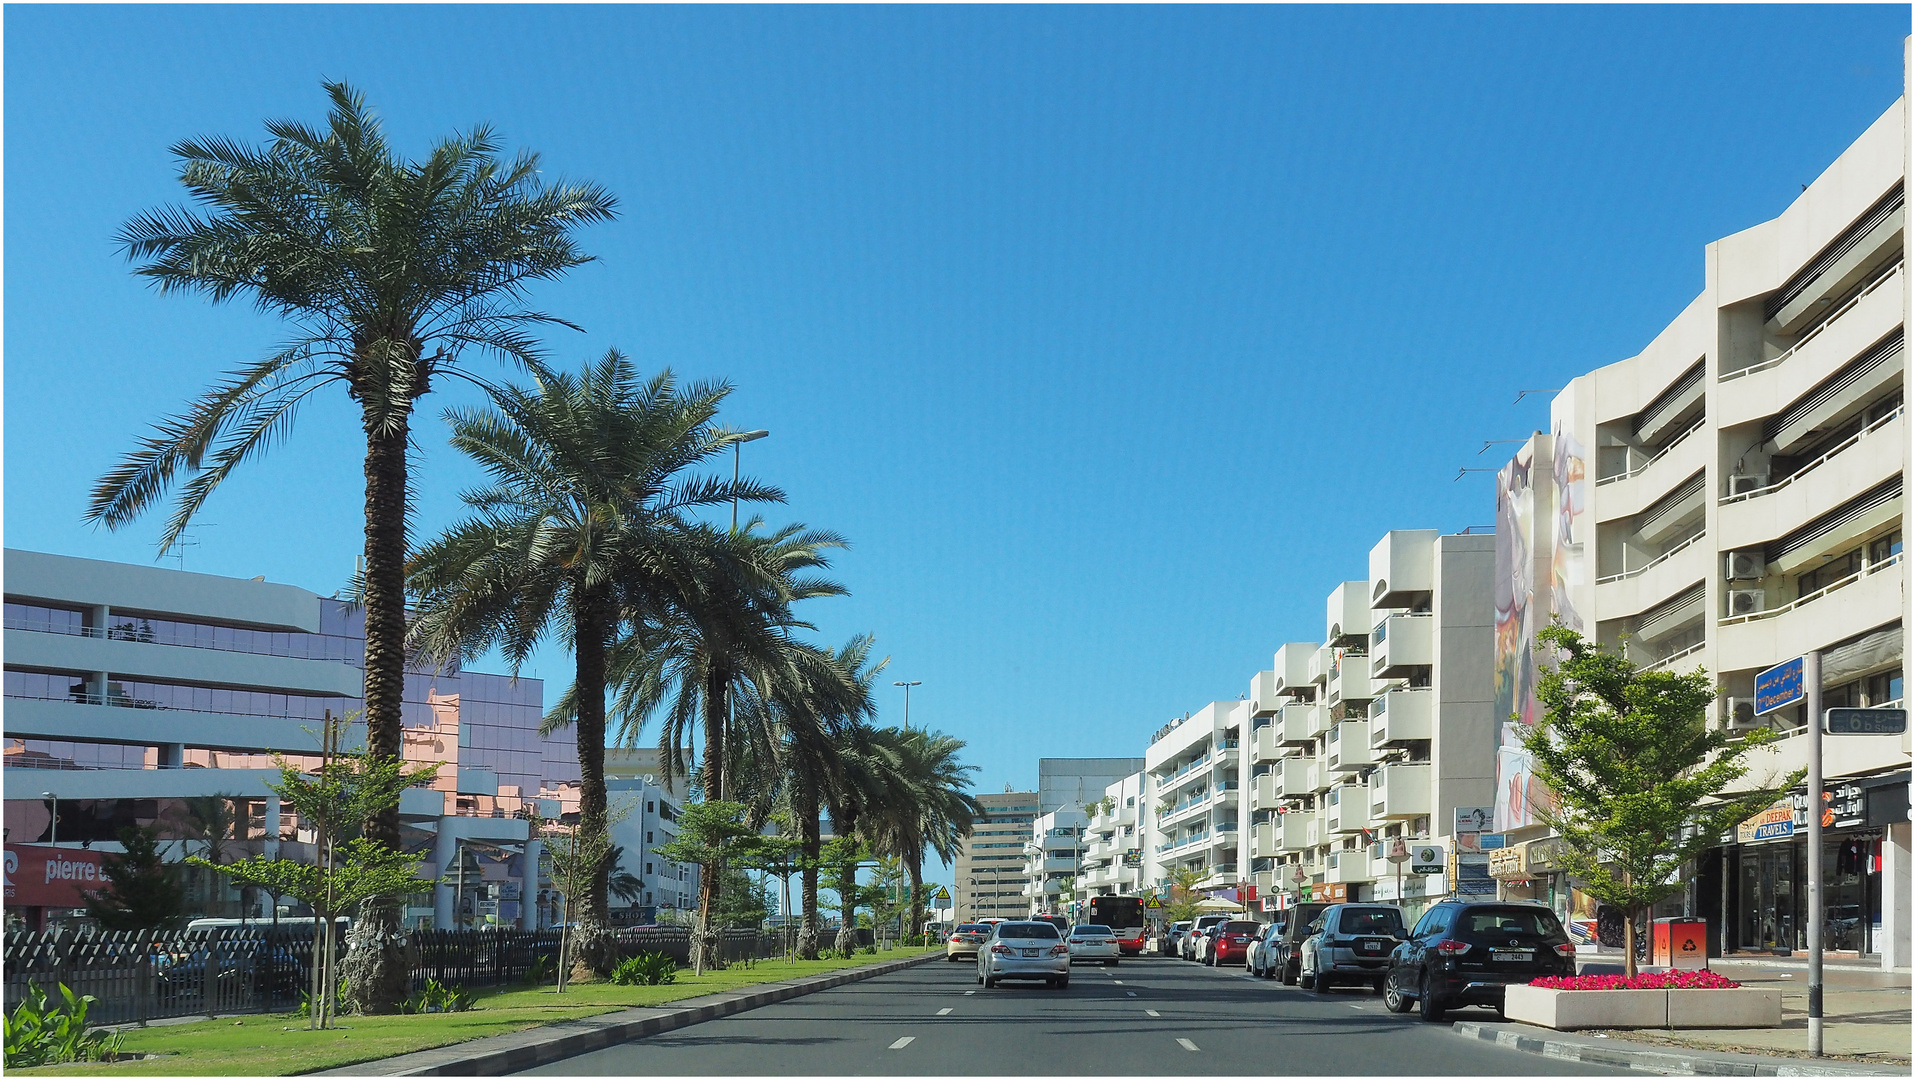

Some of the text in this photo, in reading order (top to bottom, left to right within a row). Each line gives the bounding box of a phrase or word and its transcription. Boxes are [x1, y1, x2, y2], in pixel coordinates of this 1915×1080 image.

[1765, 688, 1794, 707] December
[1796, 683, 1803, 695] S
[1850, 713, 1861, 731] 6
[1864, 721, 1872, 731] b
[1766, 810, 1792, 823] DEEPAK
[1759, 823, 1788, 837] TRAVELS
[45, 854, 95, 884] pierre
